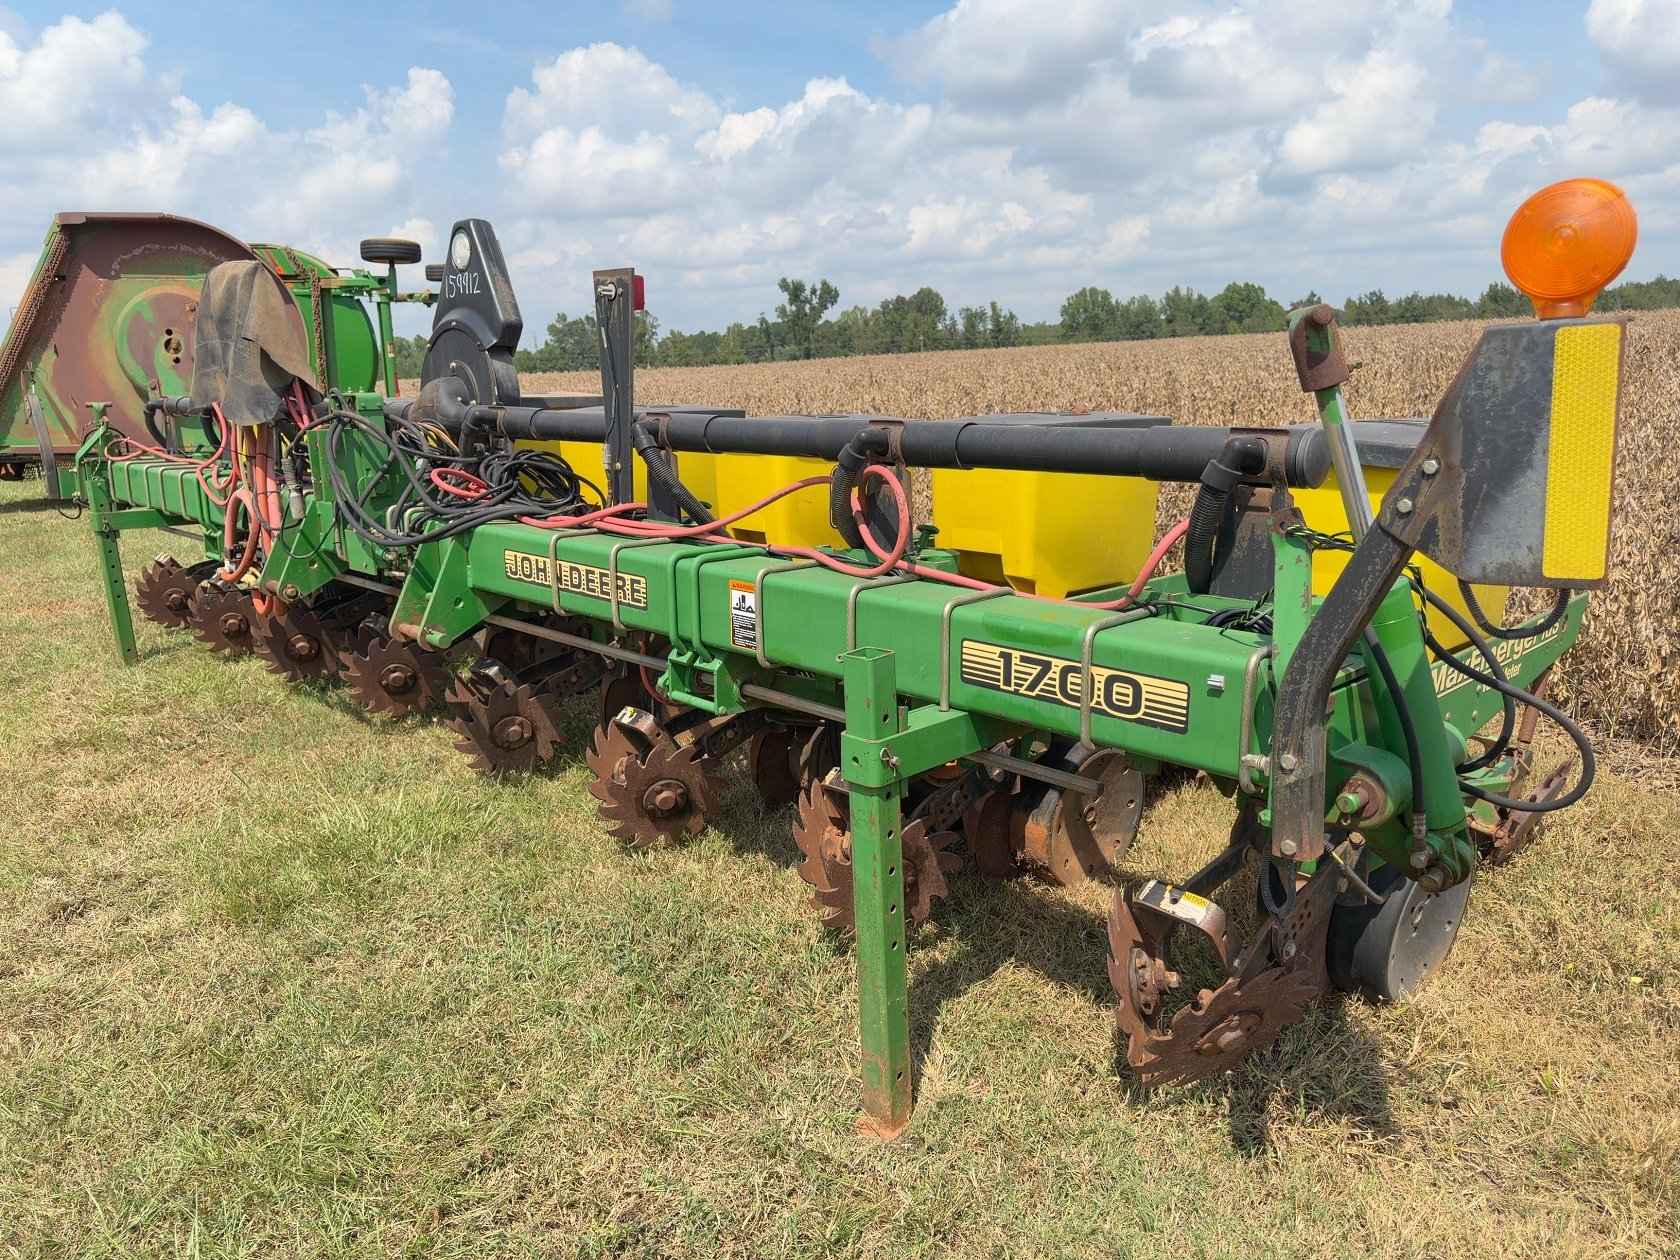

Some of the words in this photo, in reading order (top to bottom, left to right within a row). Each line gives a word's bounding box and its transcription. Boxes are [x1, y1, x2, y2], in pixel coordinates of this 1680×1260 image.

[445, 272, 481, 299] 159912
[568, 564, 644, 604] DEERE
[997, 650, 1145, 718] 1700
